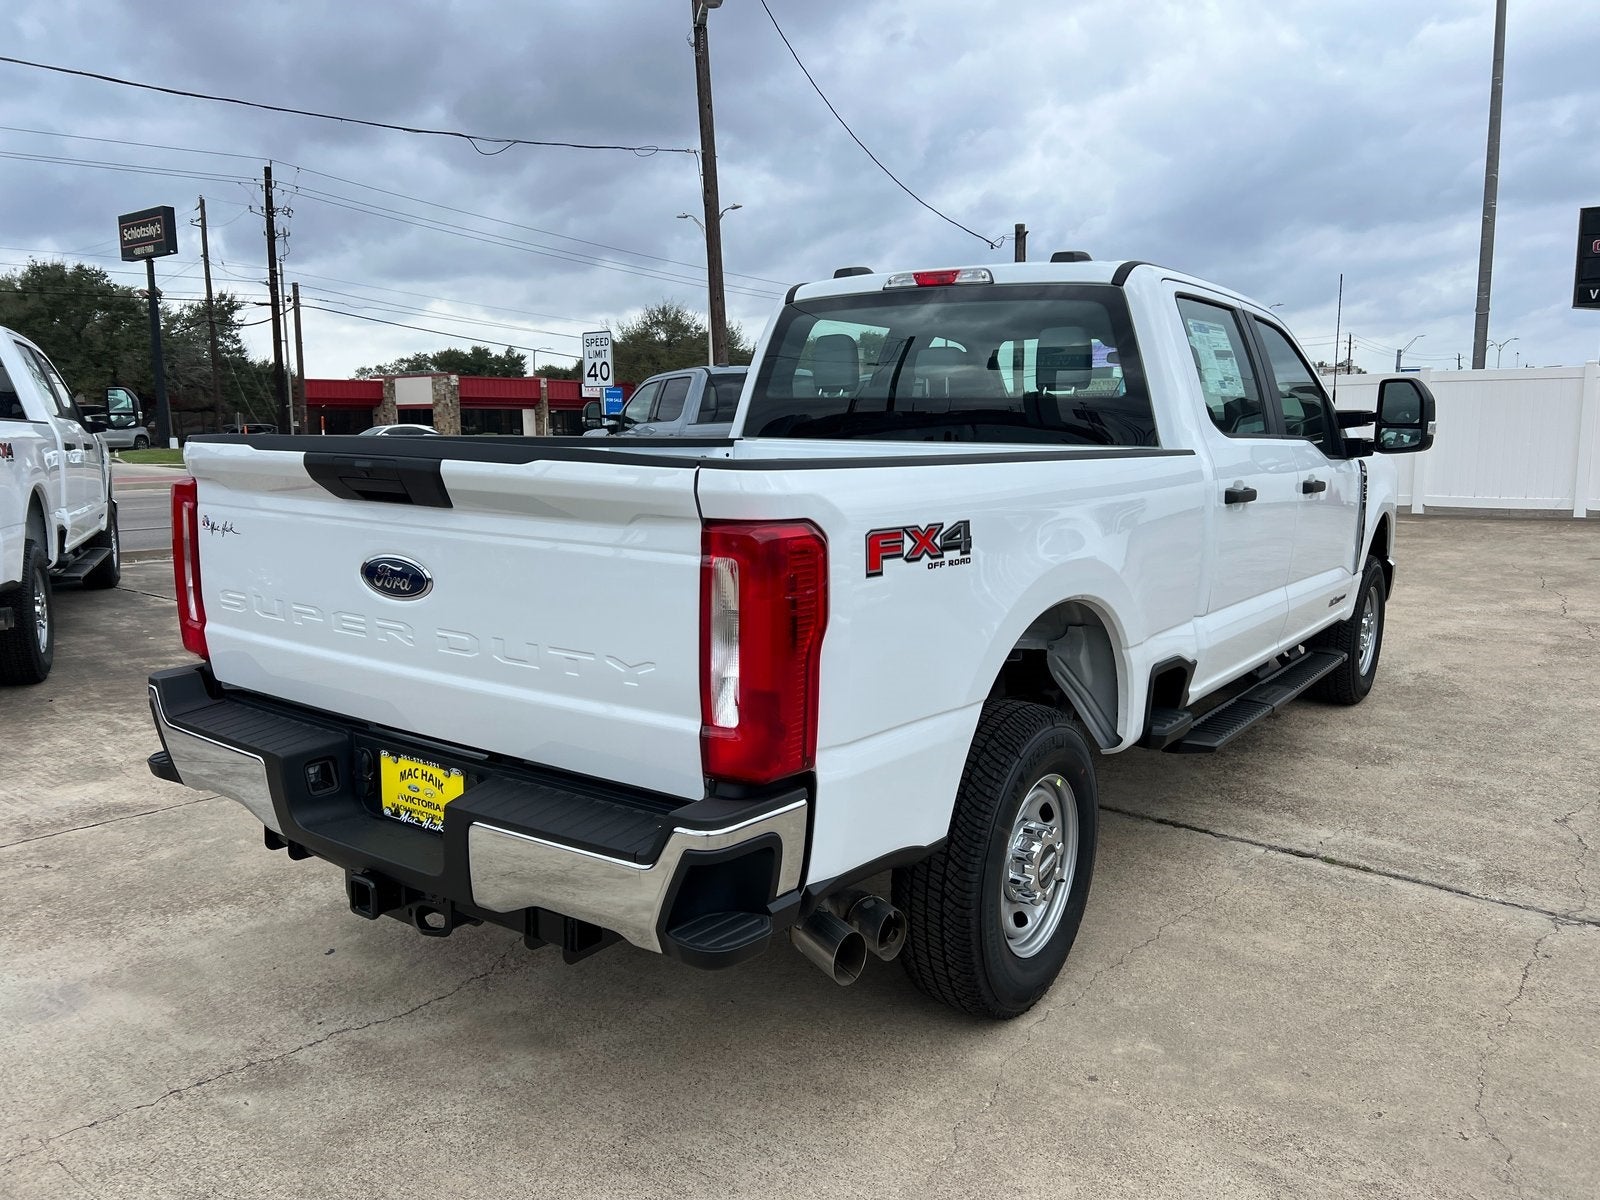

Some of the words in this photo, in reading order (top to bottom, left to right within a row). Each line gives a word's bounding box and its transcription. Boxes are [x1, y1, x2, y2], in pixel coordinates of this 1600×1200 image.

[123, 222, 161, 241] Schlotzsky's
[585, 337, 609, 348] SPEED
[588, 349, 608, 359] LIMIT
[586, 361, 610, 382] 40
[865, 519, 972, 579] FX4
[927, 562, 946, 570] OFF
[948, 557, 971, 566] ROAD
[374, 563, 412, 591] Ford
[219, 588, 415, 647] SUPER
[436, 627, 657, 687] DUTY
[399, 767, 419, 783] MAC
[421, 769, 444, 794] HAIK
[399, 810, 421, 826] Mac
[421, 817, 445, 832] Haik
